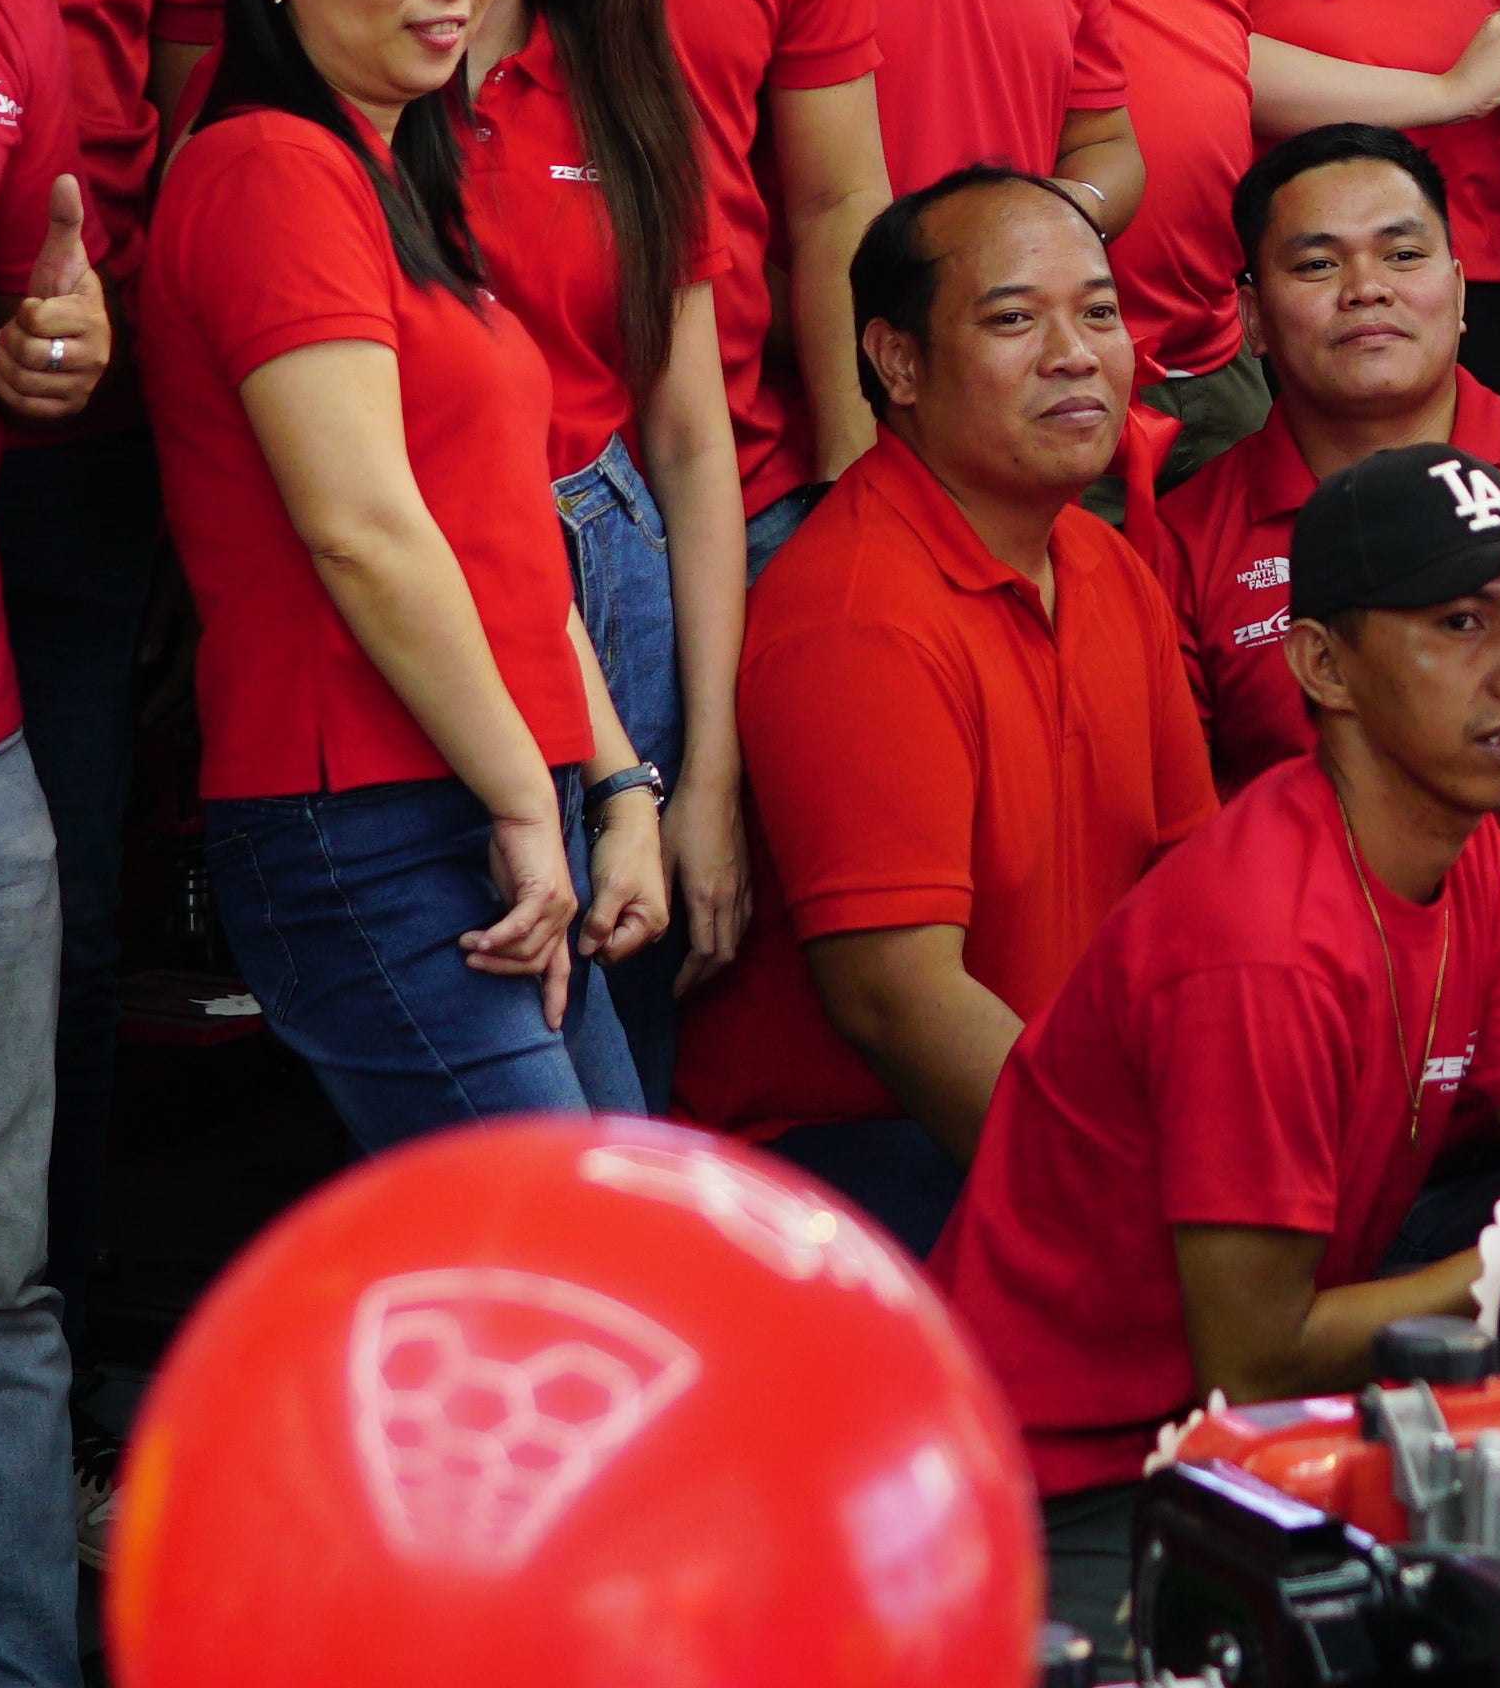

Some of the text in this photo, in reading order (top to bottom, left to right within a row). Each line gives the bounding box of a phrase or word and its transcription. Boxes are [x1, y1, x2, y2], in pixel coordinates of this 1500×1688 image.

[1253, 557, 1275, 571] THE
[1236, 566, 1277, 584] NORTH
[1248, 576, 1279, 590] FACE
